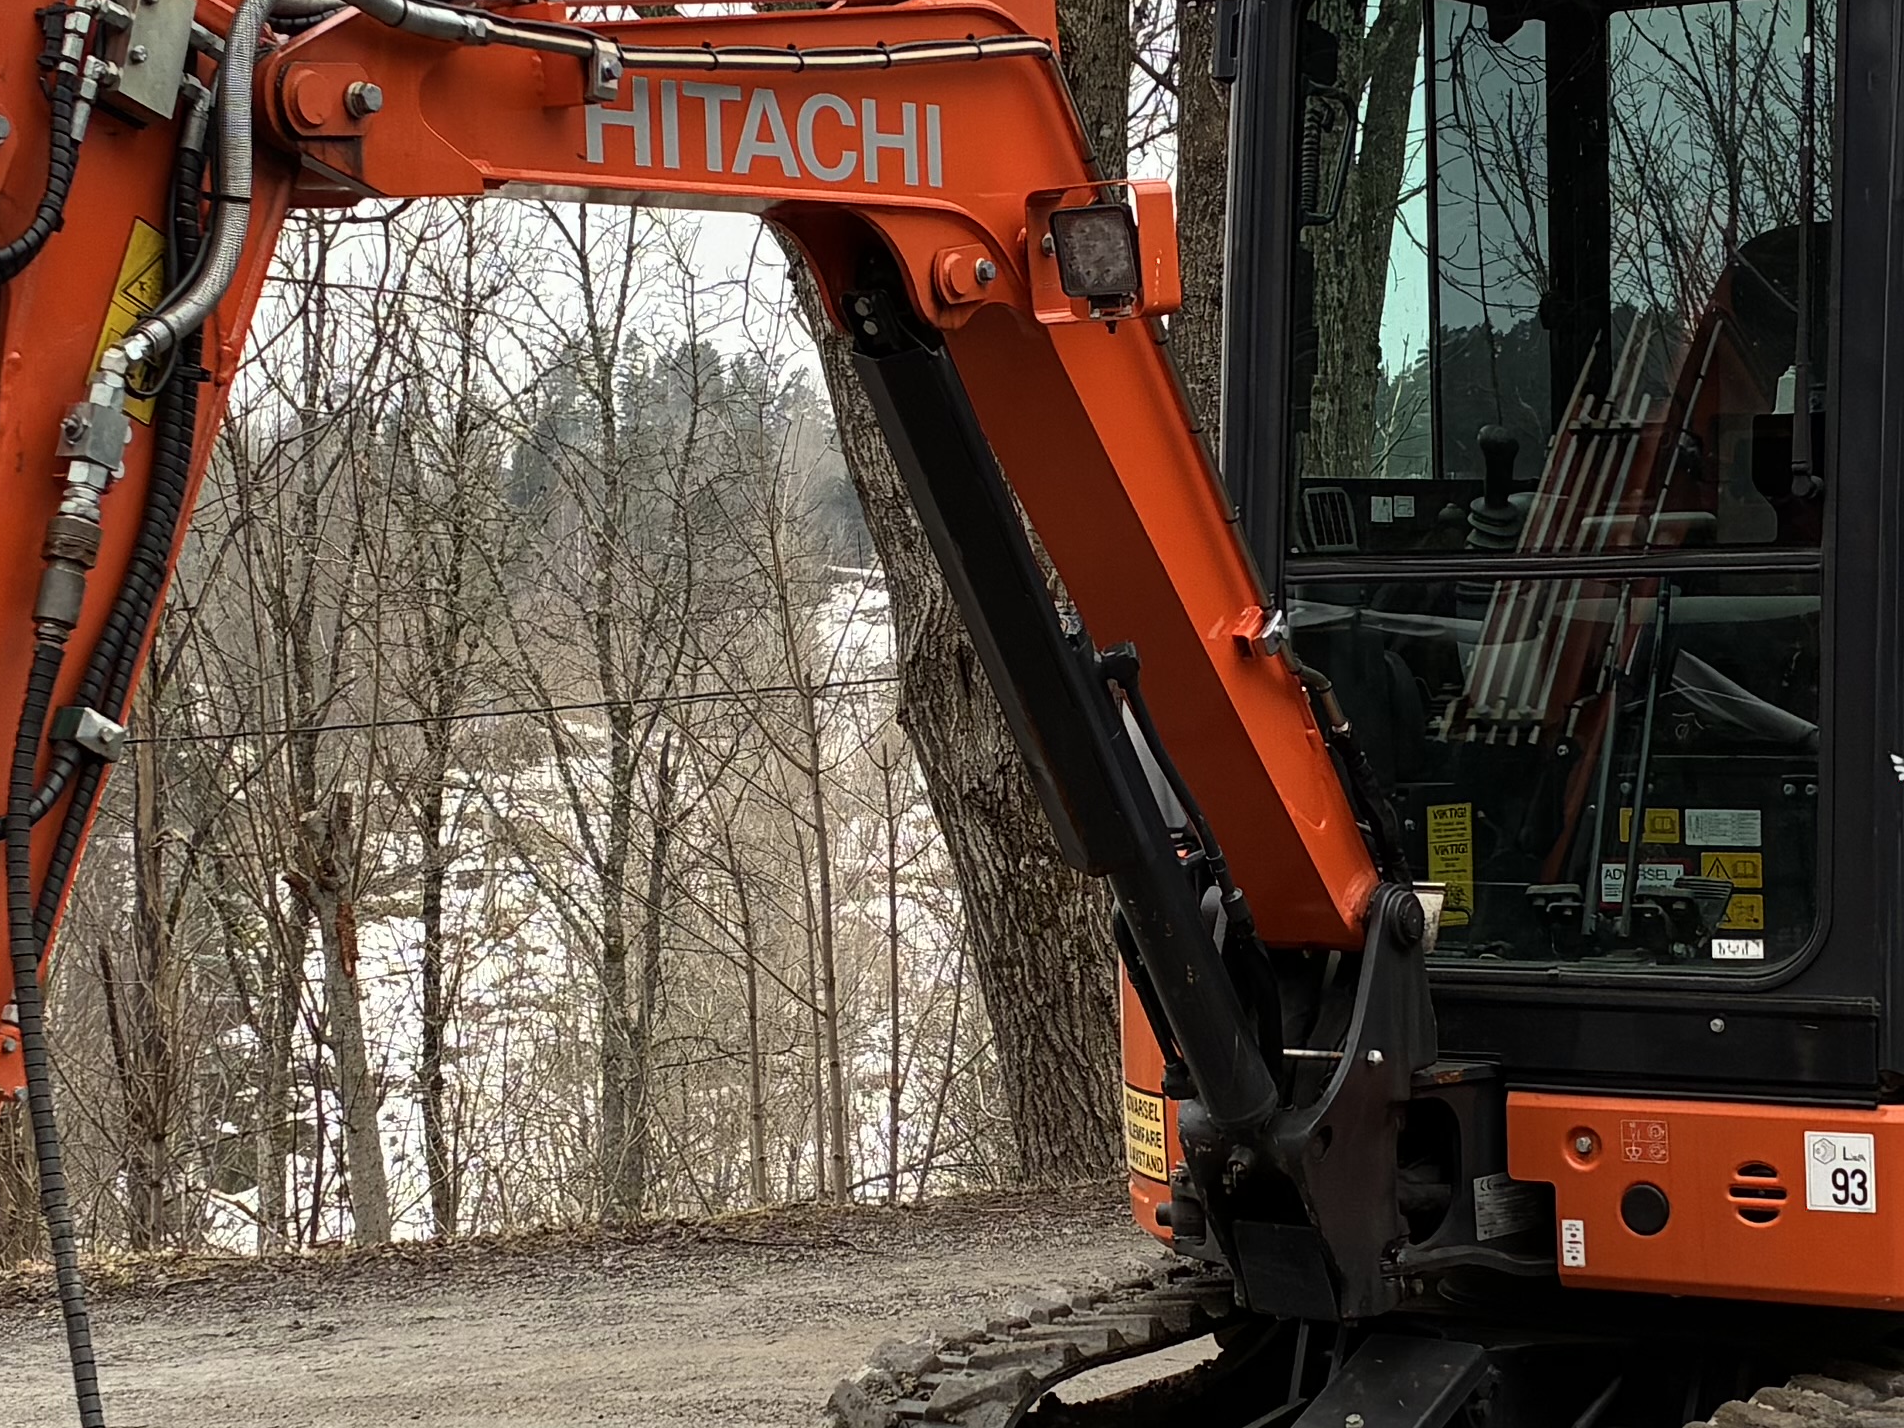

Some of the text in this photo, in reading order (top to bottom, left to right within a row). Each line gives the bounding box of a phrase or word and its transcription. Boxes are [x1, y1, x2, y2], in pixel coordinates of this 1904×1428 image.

[584, 76, 943, 188] HITACHI
[1604, 868, 1673, 881] ADRSEL
[1831, 1167, 1868, 1206] 93
